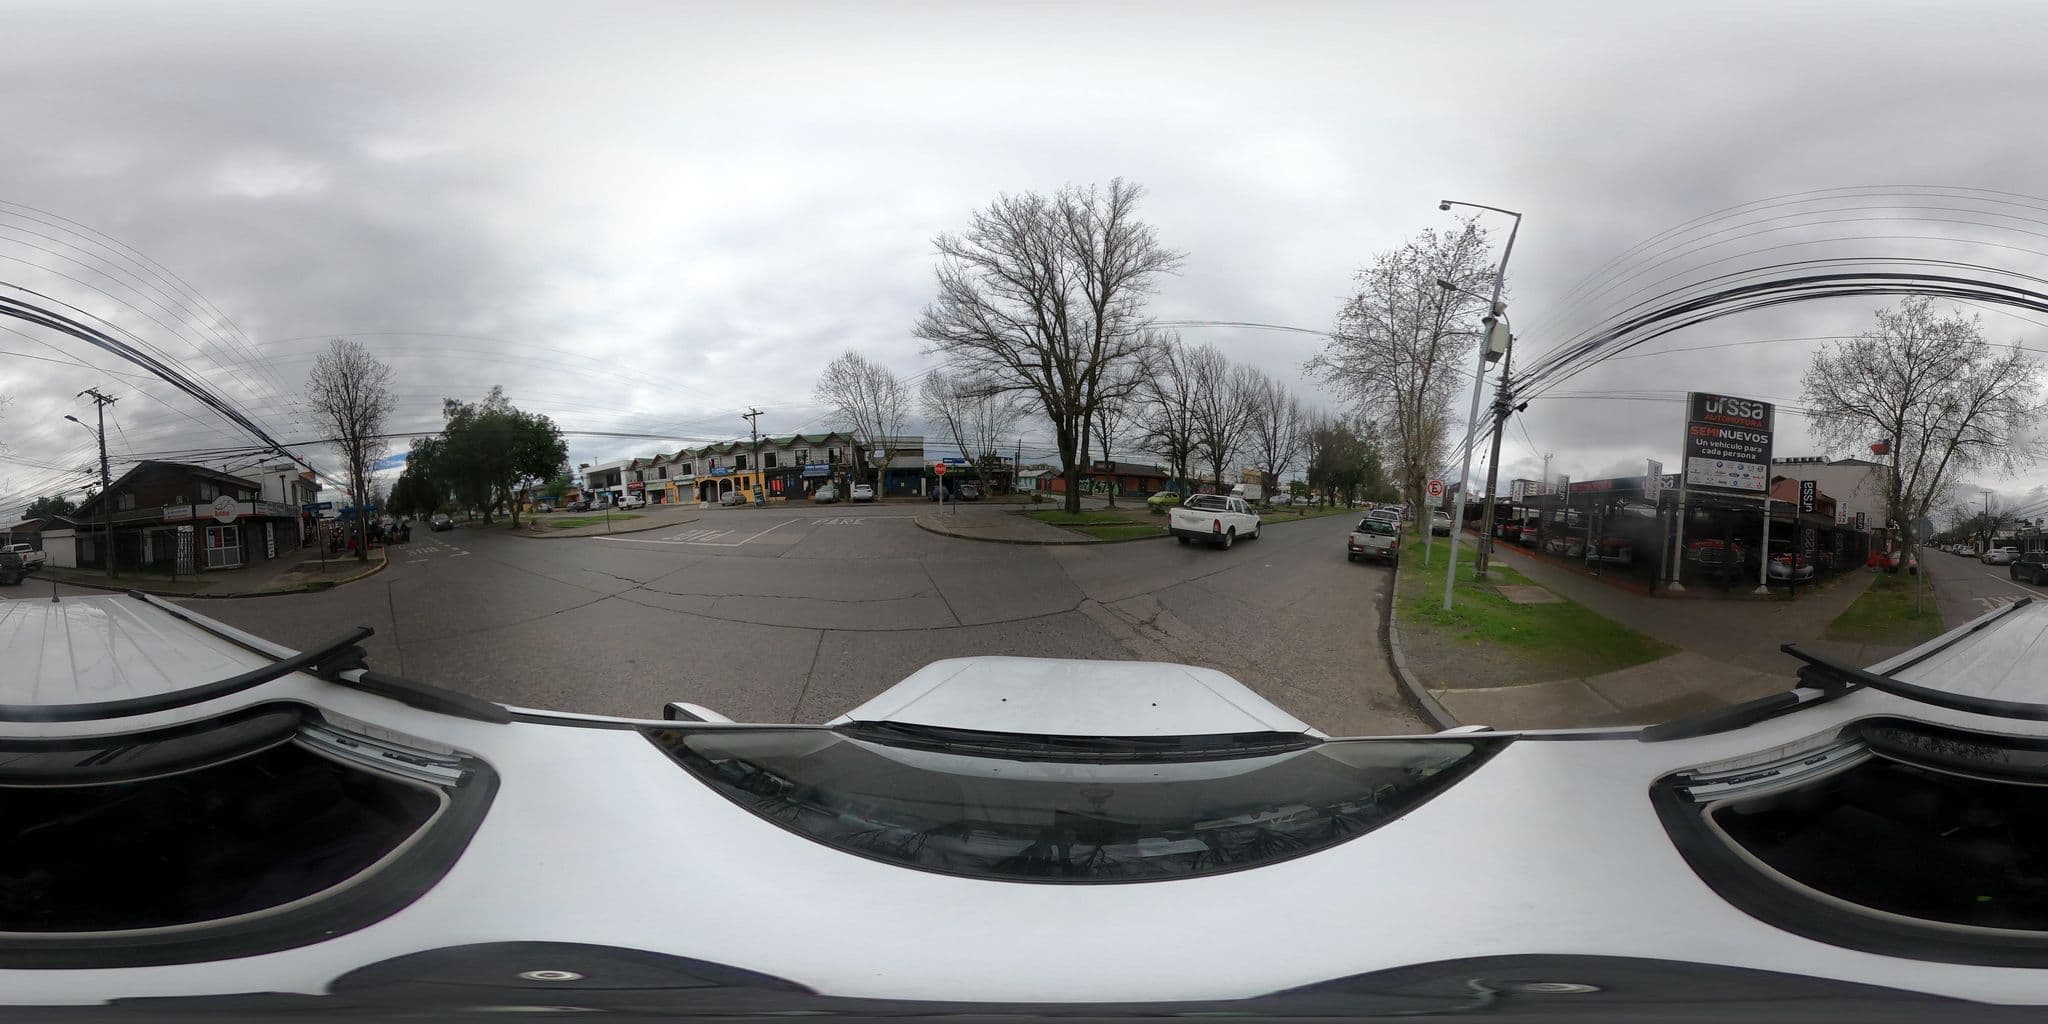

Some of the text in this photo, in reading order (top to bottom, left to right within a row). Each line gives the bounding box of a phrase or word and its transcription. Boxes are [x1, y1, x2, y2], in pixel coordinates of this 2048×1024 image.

[1706, 397, 1763, 420] urssa
[1690, 426, 1769, 444] SEMINUEVOS
[1695, 438, 1708, 446] Un
[1744, 445, 1762, 453] para
[1701, 448, 1756, 460] cada persona
[1803, 481, 1814, 512] urssa
